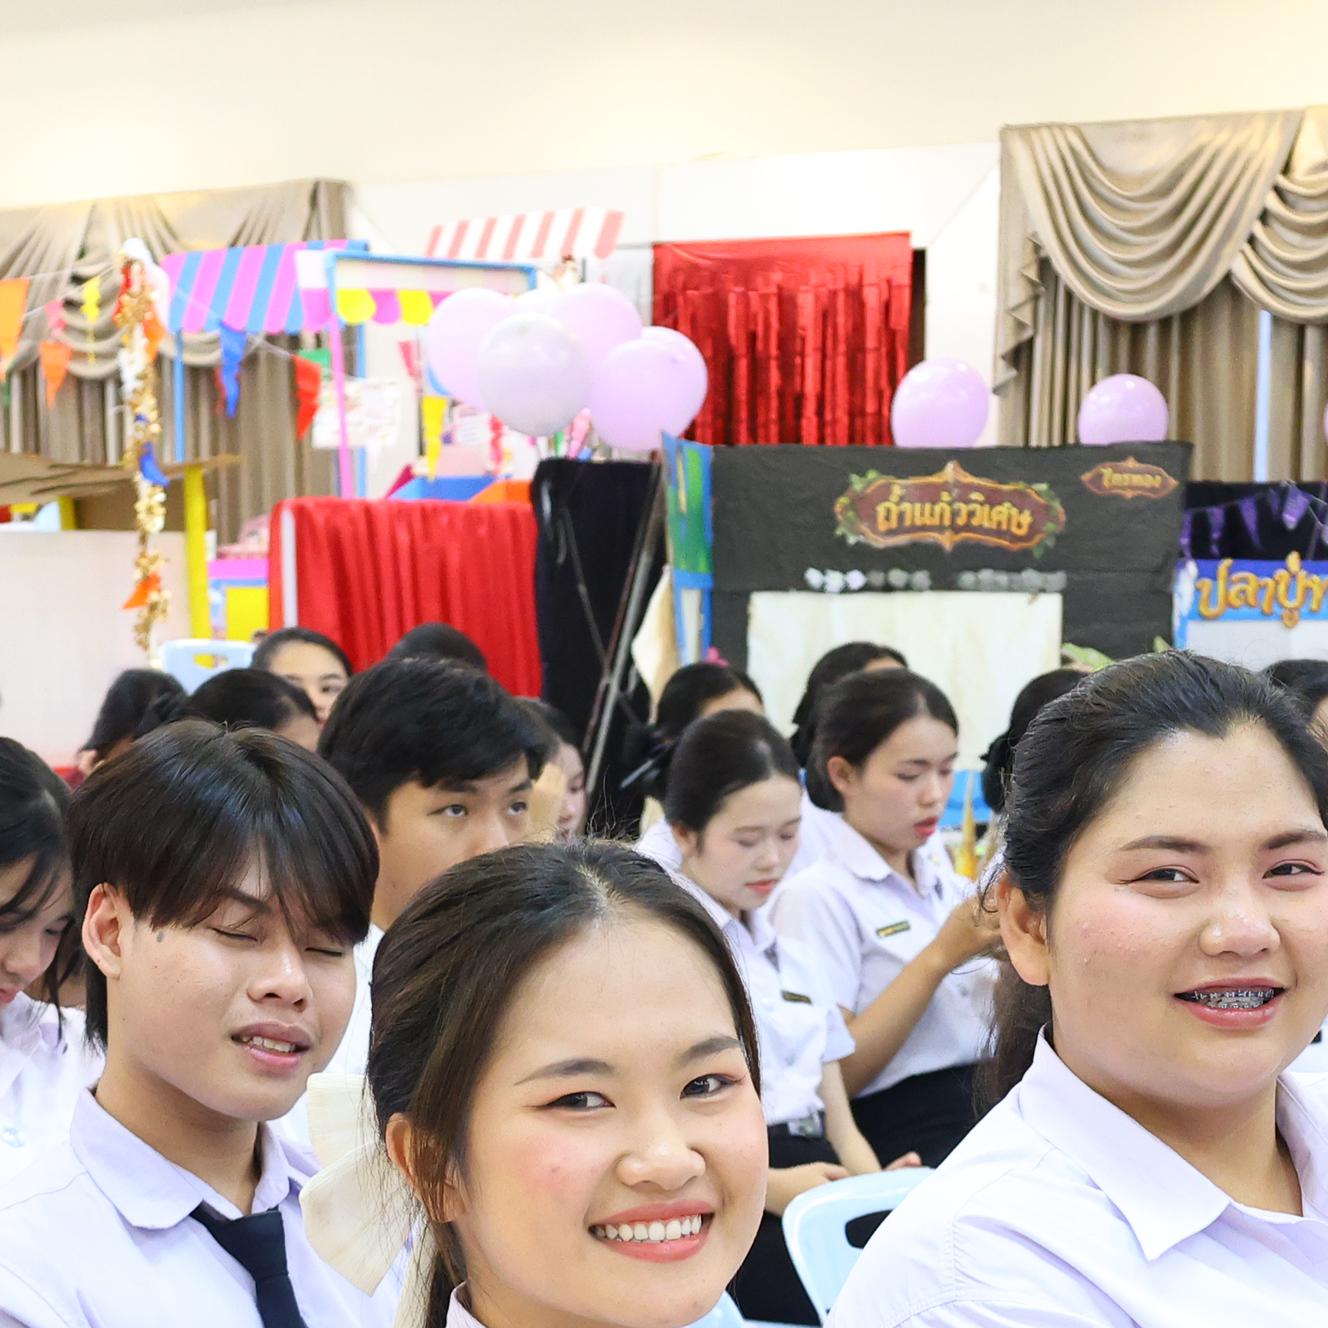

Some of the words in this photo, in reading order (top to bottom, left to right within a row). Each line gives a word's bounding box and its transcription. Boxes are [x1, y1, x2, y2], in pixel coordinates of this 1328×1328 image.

[876, 483, 1033, 536] ถ้ำแก้ววิเศษ
